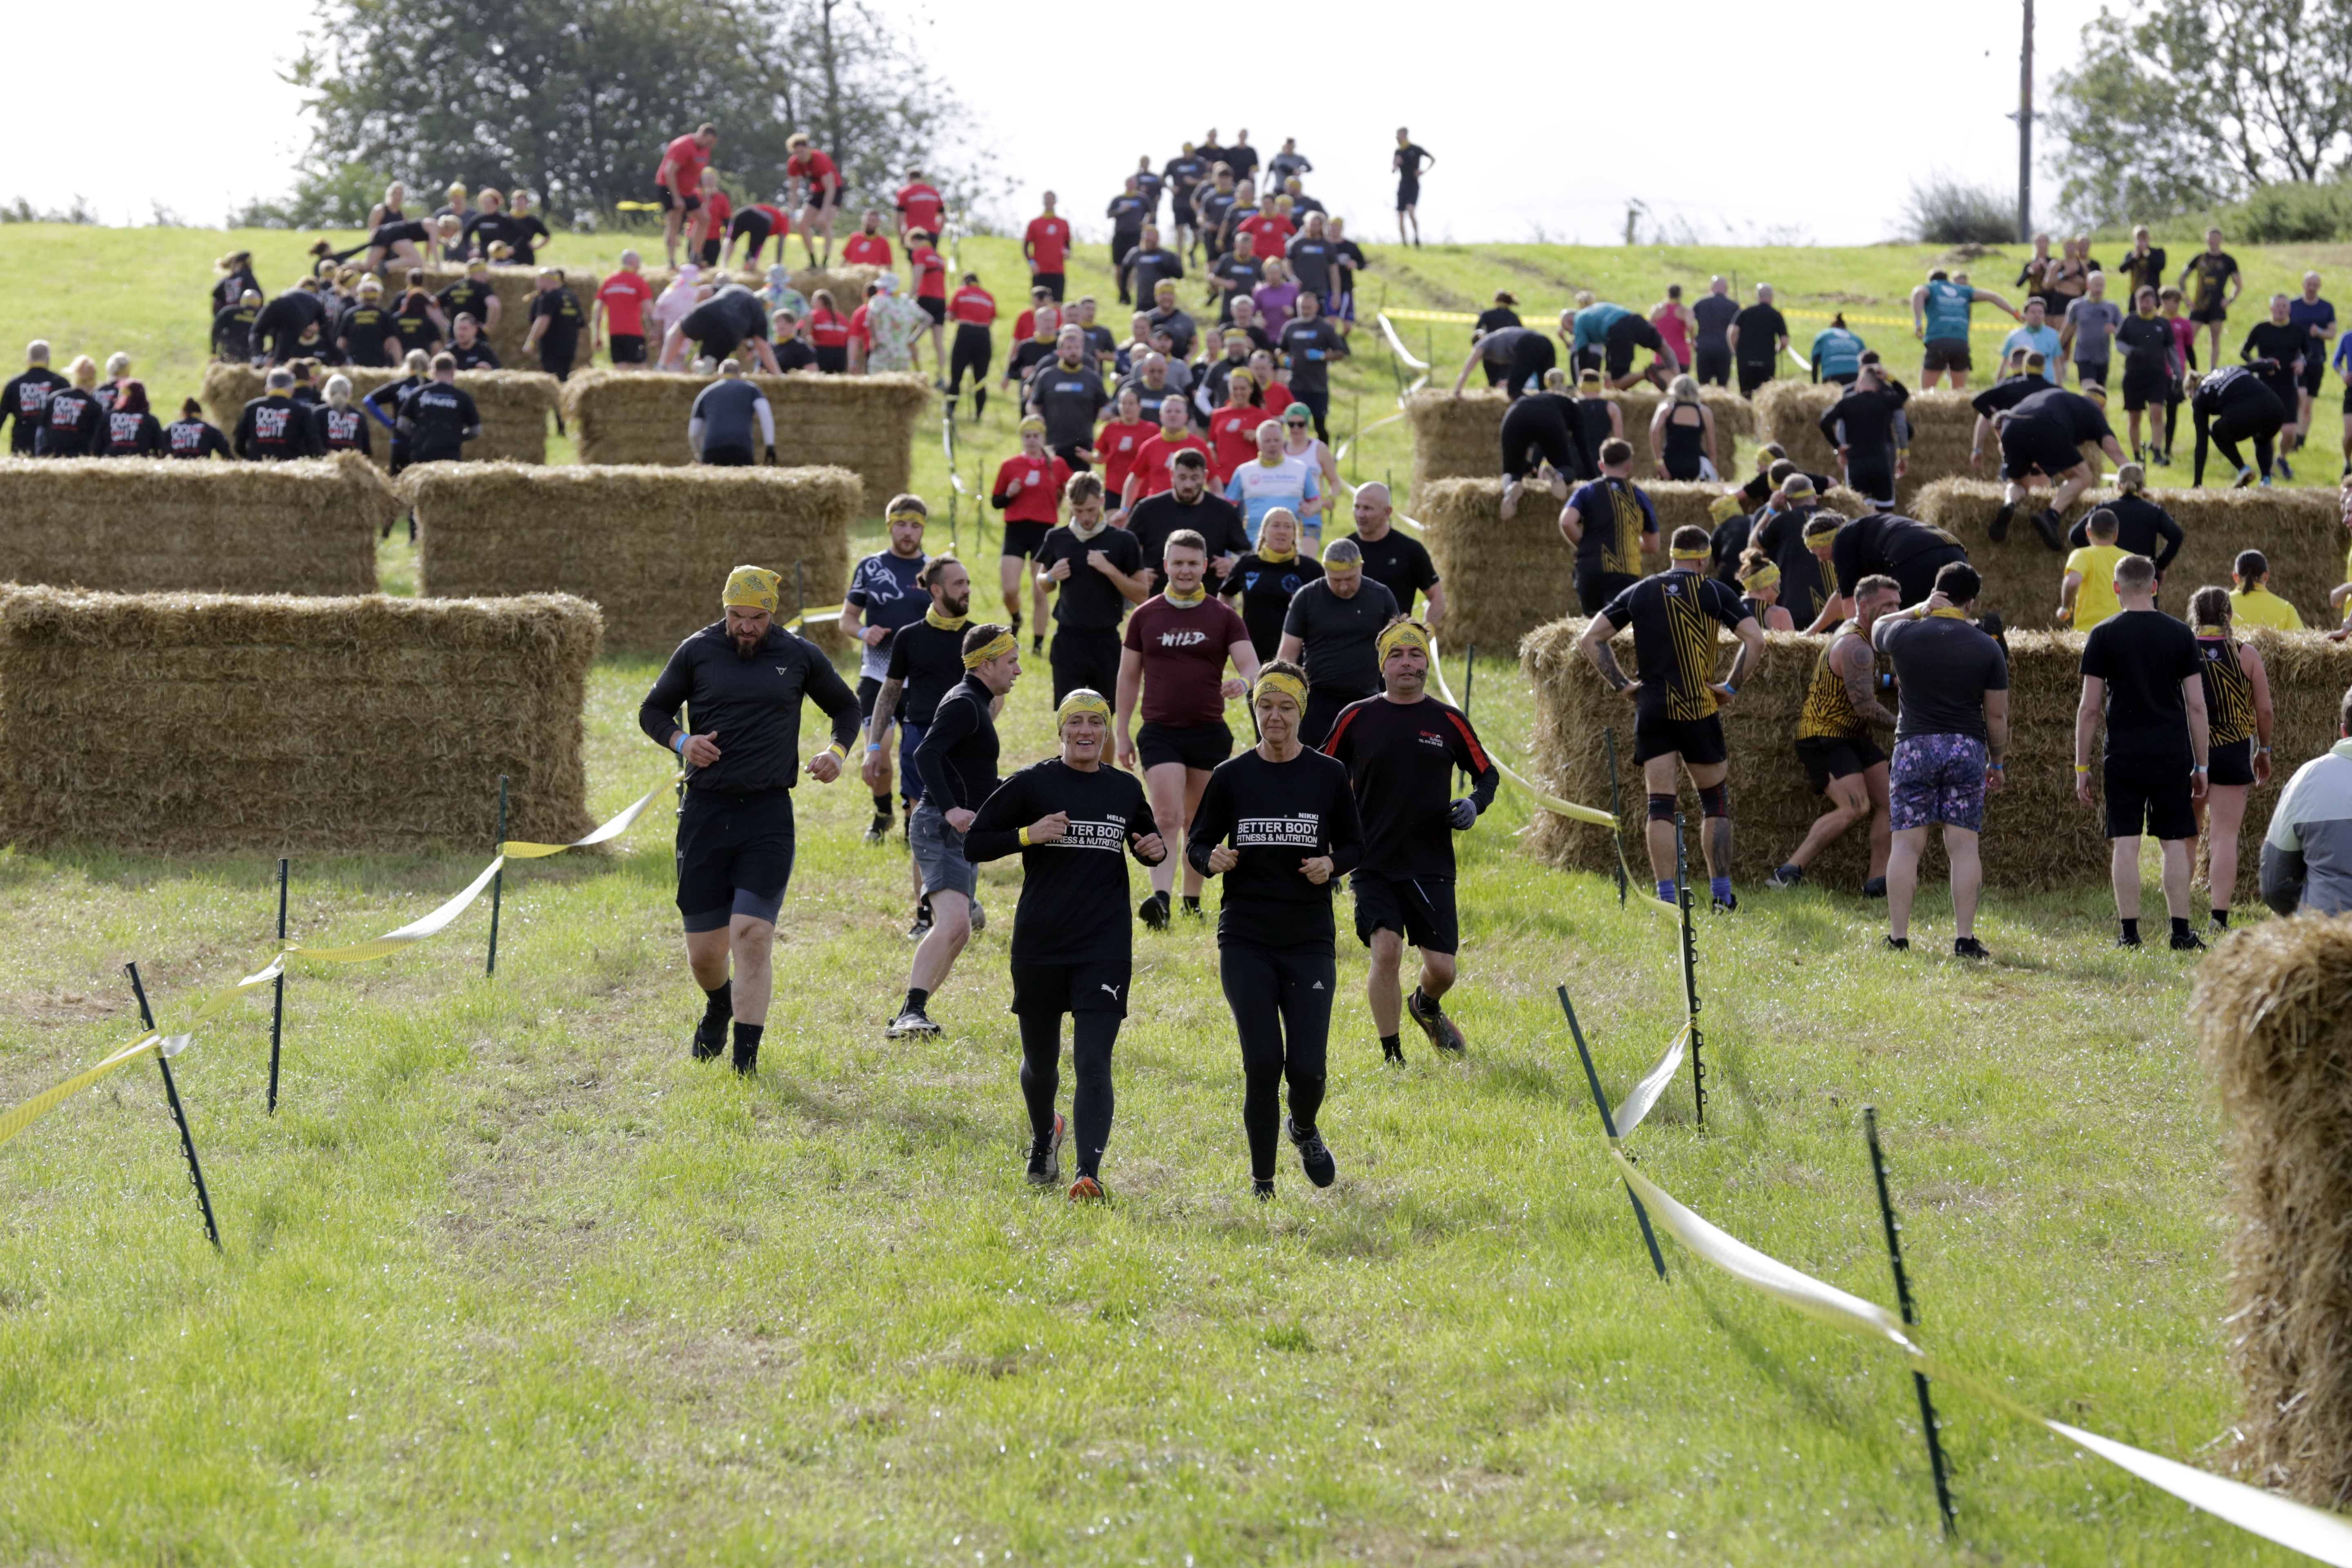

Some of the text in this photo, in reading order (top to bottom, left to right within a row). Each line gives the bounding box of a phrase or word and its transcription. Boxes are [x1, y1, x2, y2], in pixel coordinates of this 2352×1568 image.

[1161, 632, 1206, 646] WILD
[1107, 814, 1125, 824] HELEN
[1097, 826, 1124, 840] BODY
[1238, 822, 1318, 835] BETTER BODY
[1086, 837, 1122, 849] NUTRITION
[1237, 833, 1267, 842] FITNESS
[1276, 833, 1318, 844] NUTRITION
